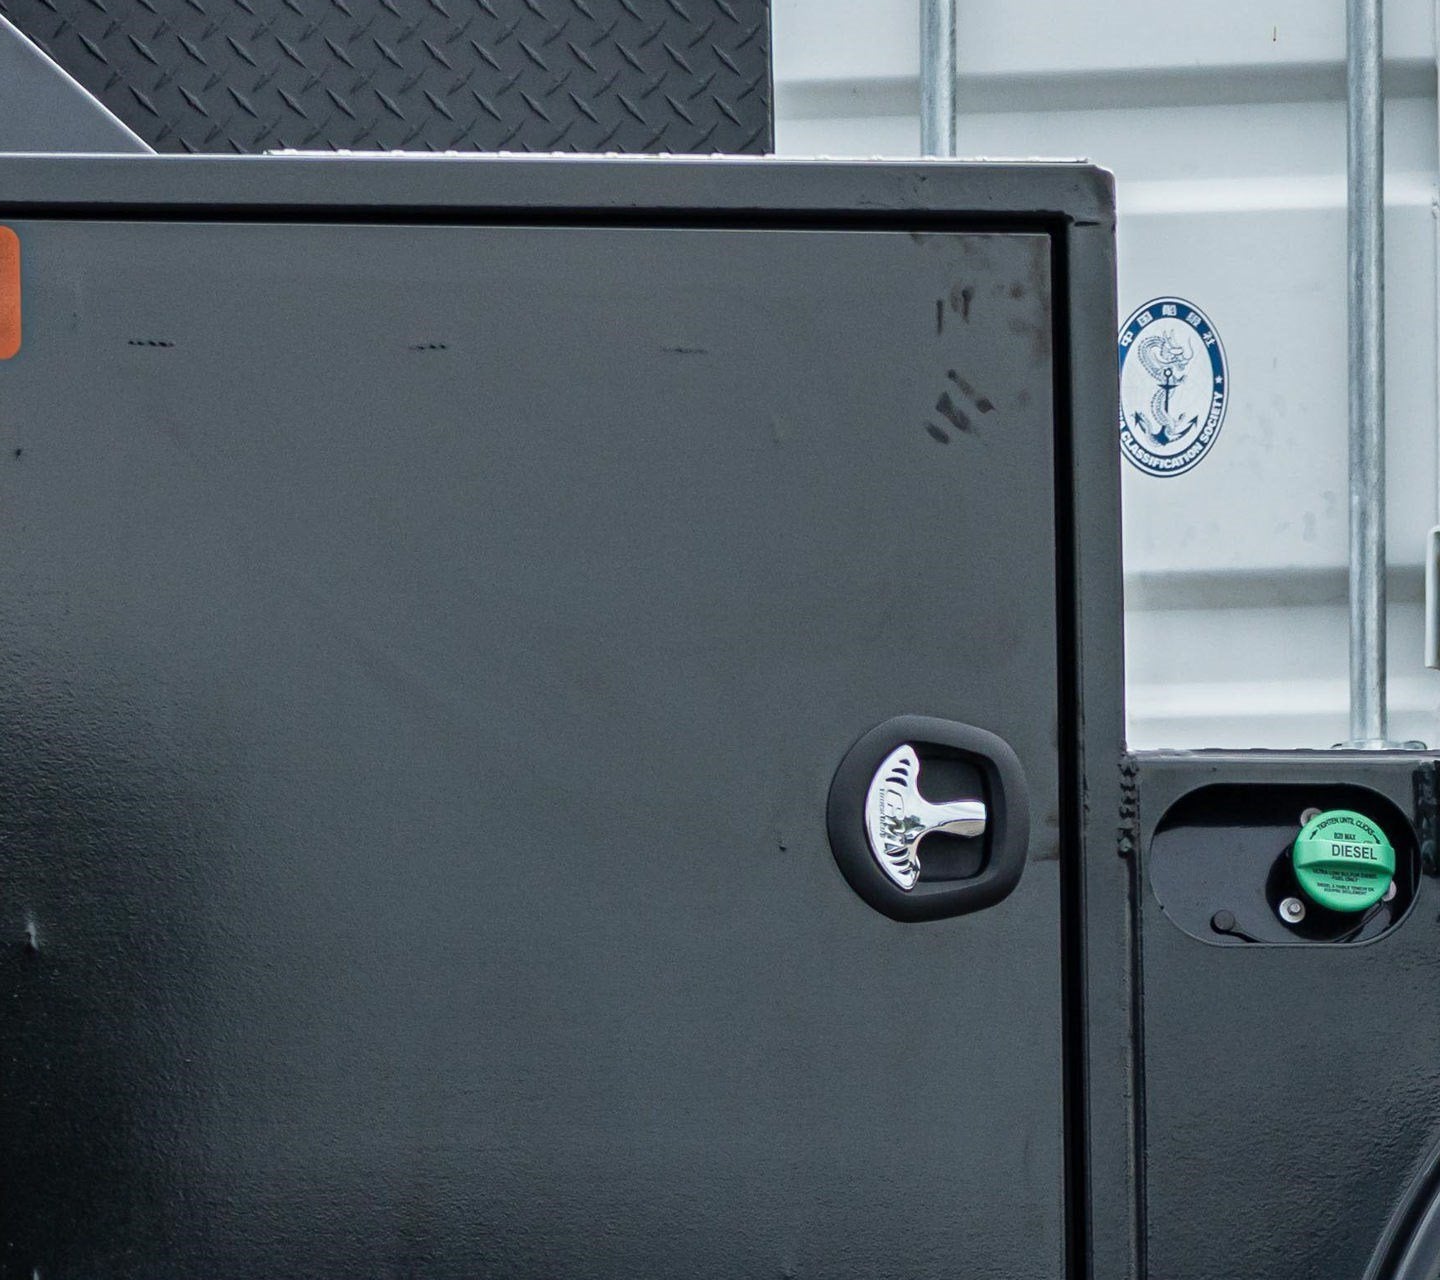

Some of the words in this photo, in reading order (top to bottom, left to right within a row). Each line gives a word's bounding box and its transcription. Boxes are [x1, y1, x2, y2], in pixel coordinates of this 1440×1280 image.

[1121, 430, 1203, 469] CLASSIFICATION
[1201, 391, 1224, 444] SOCIETY
[1332, 844, 1377, 861] DIESEL
